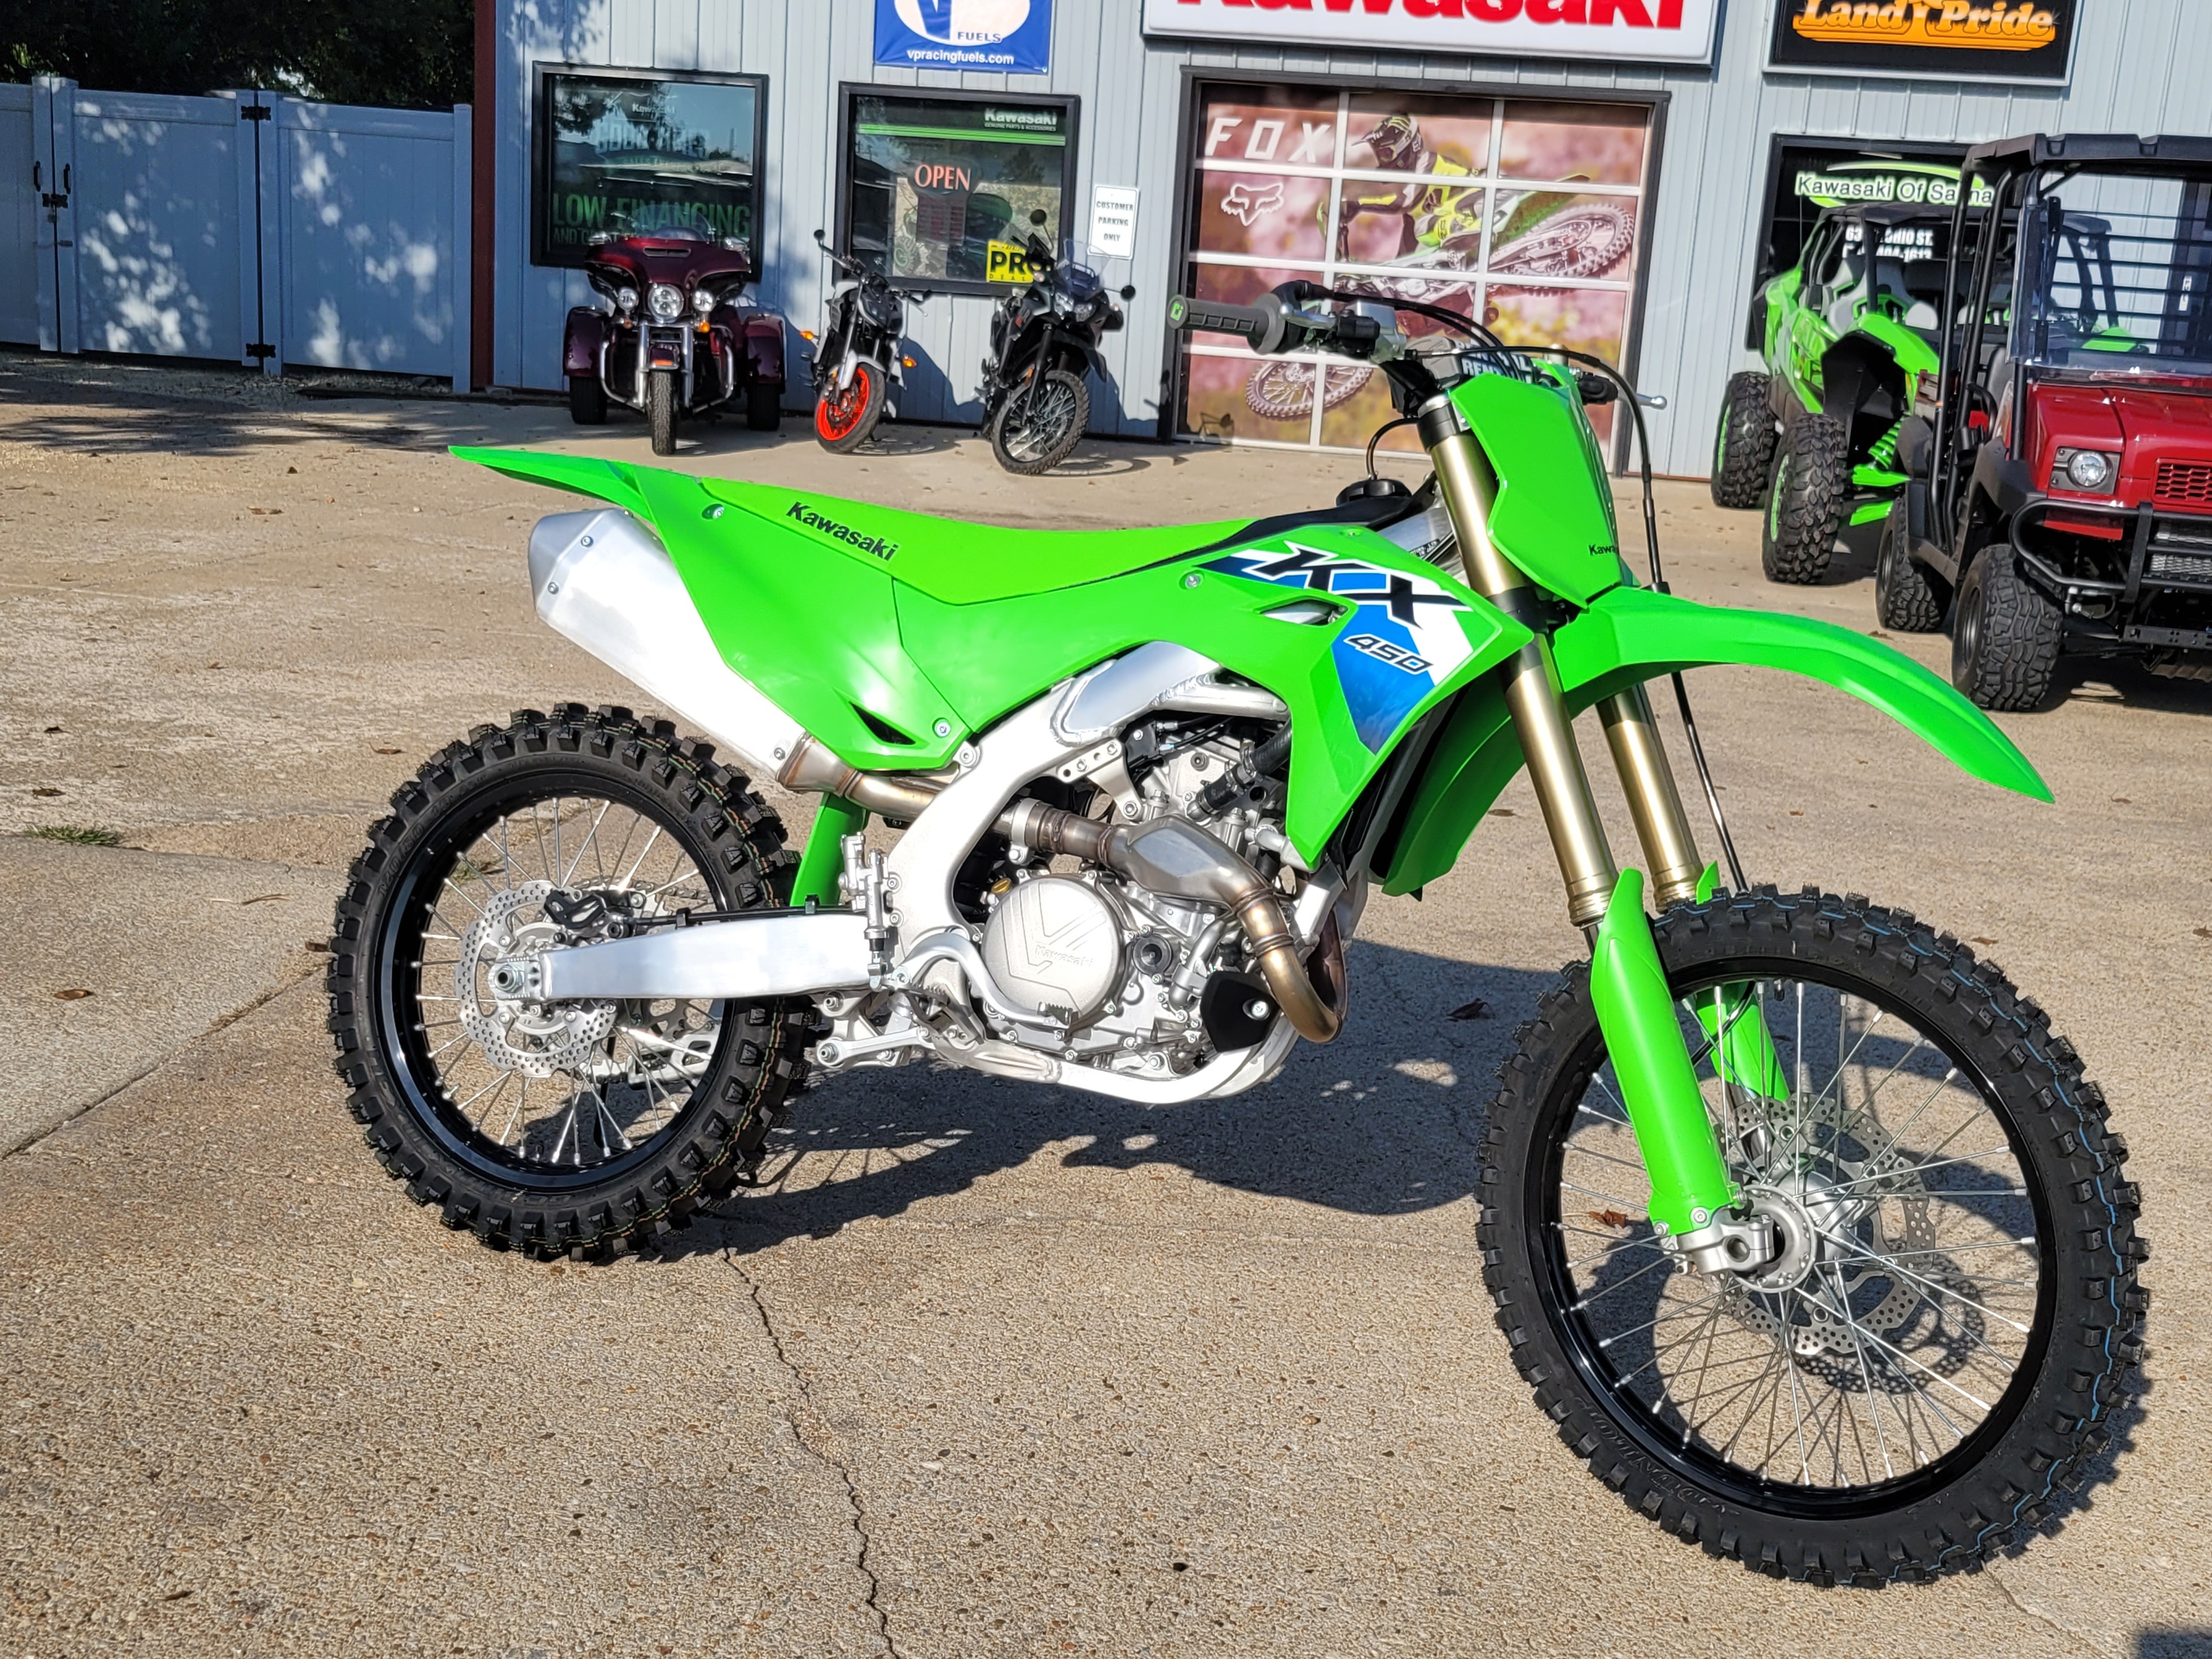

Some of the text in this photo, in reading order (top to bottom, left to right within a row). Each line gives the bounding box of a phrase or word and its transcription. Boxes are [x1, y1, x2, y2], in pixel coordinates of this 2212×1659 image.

[1799, 0, 2053, 37] Land Pride
[957, 31, 1001, 42] FUELS
[907, 49, 1014, 65] vpracingfuels.com
[984, 108, 1057, 125] Kawasaki
[1205, 117, 1331, 163] FOX
[914, 164, 971, 191] OPEN
[1798, 177, 1992, 203] Kawasaki Of Sana
[552, 193, 607, 227] LOW
[617, 198, 751, 237] FINANCING
[1096, 201, 1133, 211] CUSTOMER
[1098, 217, 1129, 227] PARKING
[1104, 233, 1120, 242] ONLY
[786, 501, 899, 562] Kawasaki
[1241, 541, 1472, 630] KX
[1344, 634, 1435, 675] 450
[1035, 945, 1094, 967] Kawasaki
